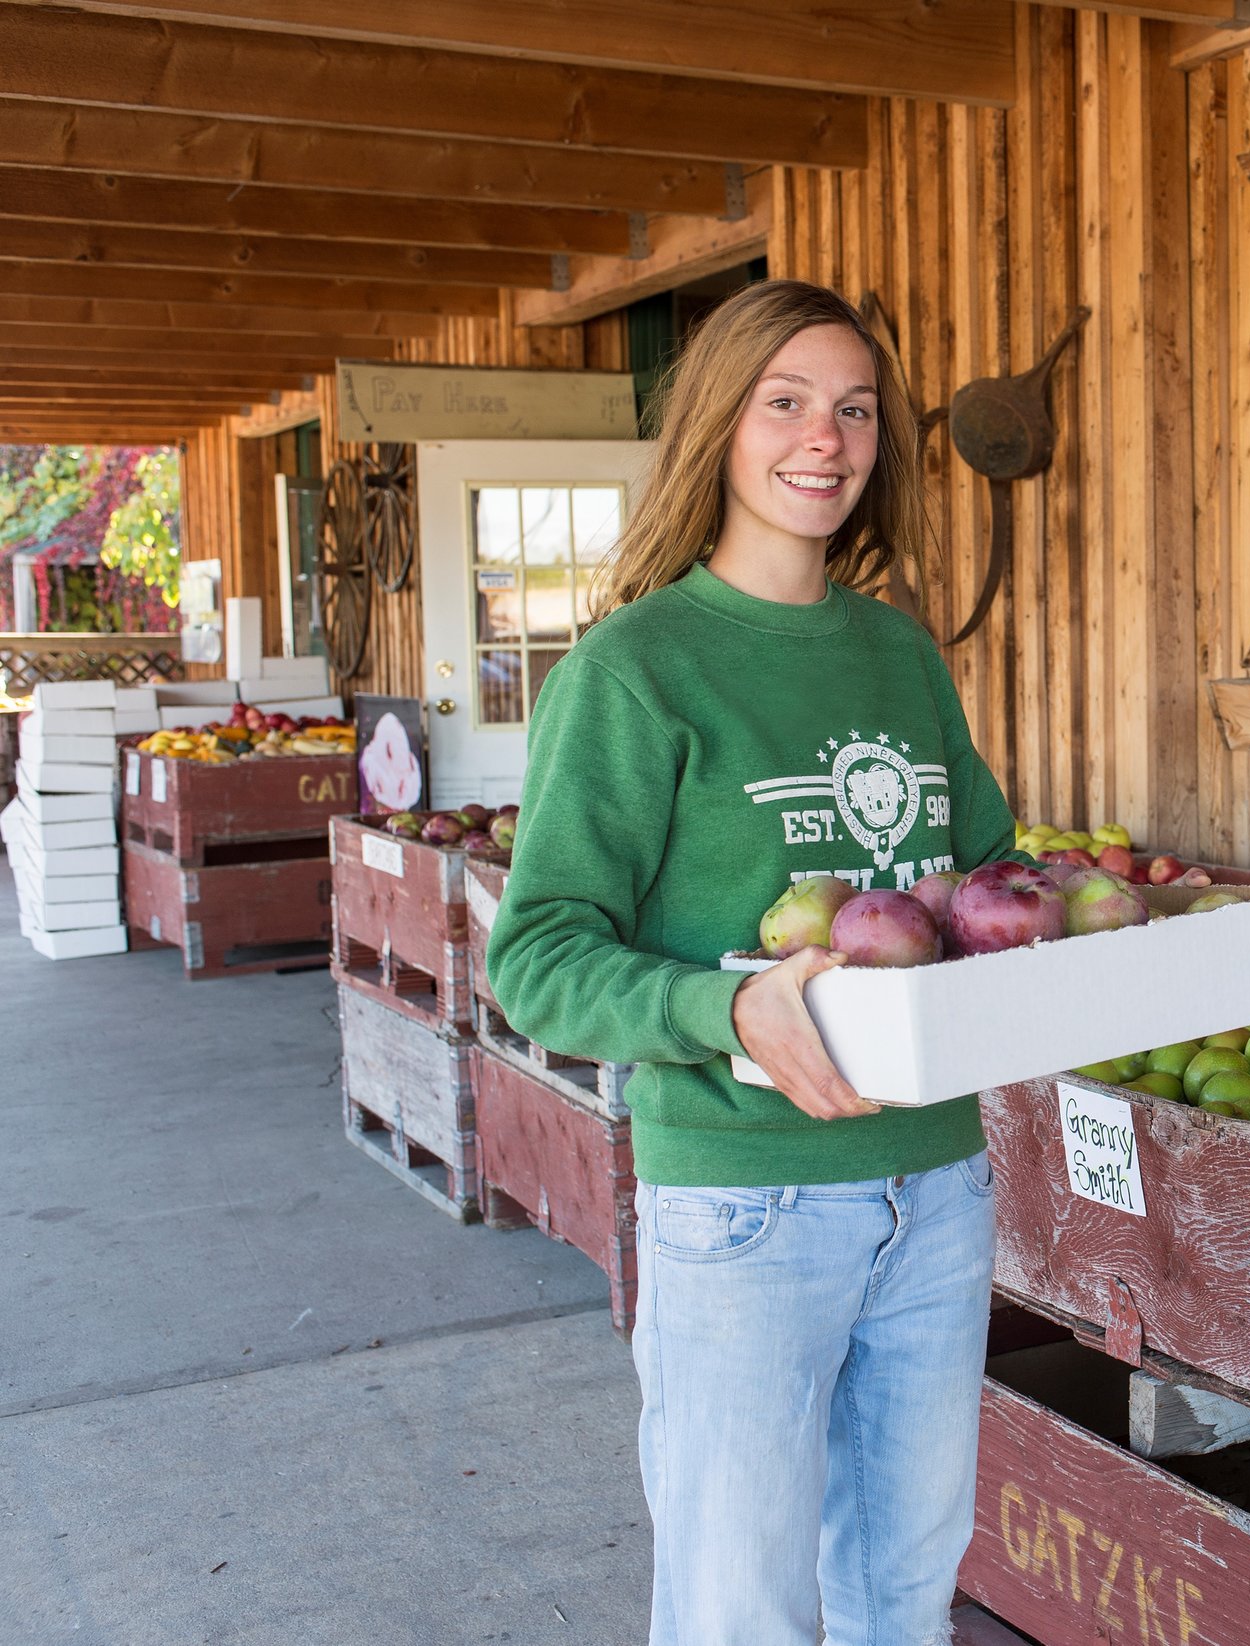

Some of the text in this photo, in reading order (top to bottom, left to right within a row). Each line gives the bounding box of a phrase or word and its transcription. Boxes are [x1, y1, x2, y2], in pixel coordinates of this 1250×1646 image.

[834, 750, 865, 837] ESTABLISHED
[781, 809, 843, 845] EST.
[1066, 1098, 1134, 1169] Granny
[1073, 1149, 1134, 1209] Smith
